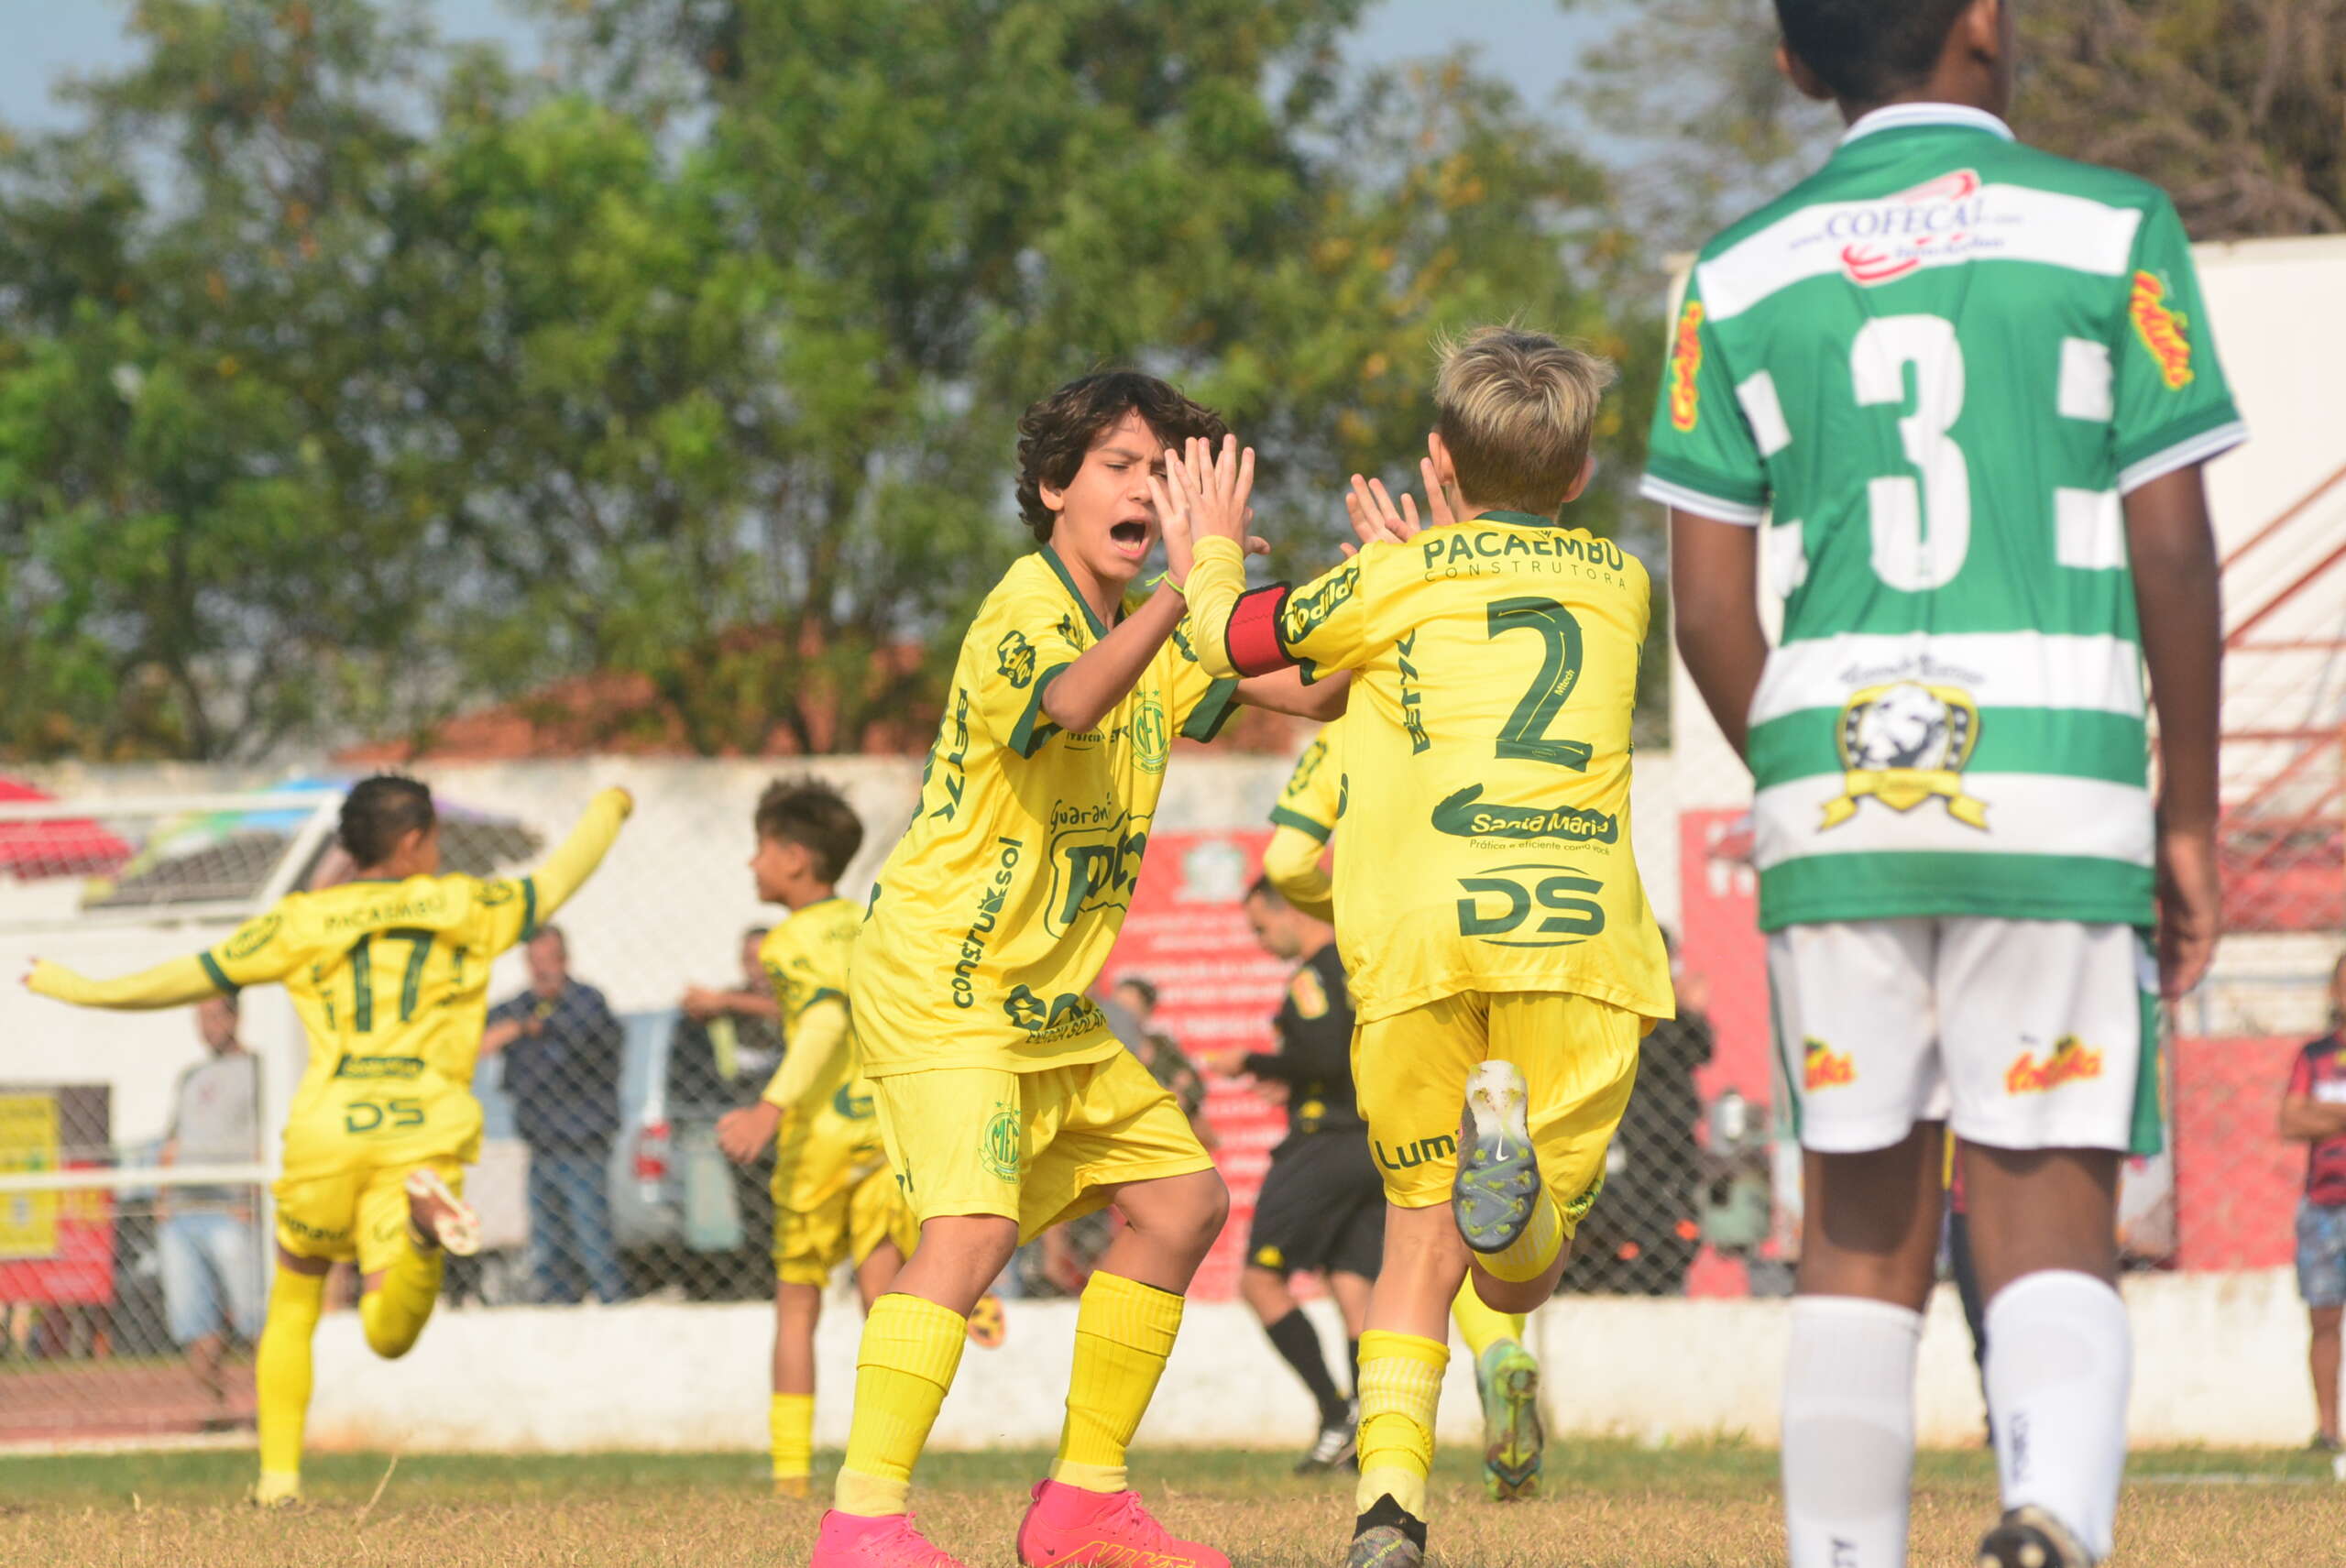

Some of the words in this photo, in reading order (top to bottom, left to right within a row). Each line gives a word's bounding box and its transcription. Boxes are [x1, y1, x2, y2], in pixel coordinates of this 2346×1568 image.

[1849, 313, 1971, 593] 3
[1423, 532, 1625, 572] PACAEMBU
[1424, 561, 1627, 591] CONSTRUTORA
[1486, 596, 1594, 773] 2
[1470, 838, 1506, 850] Prática
[1518, 840, 1562, 850] eficiente
[1457, 876, 1606, 937] DS
[346, 928, 441, 1033] 17
[346, 1099, 424, 1134] DS
[1375, 1128, 1459, 1170] Lum
